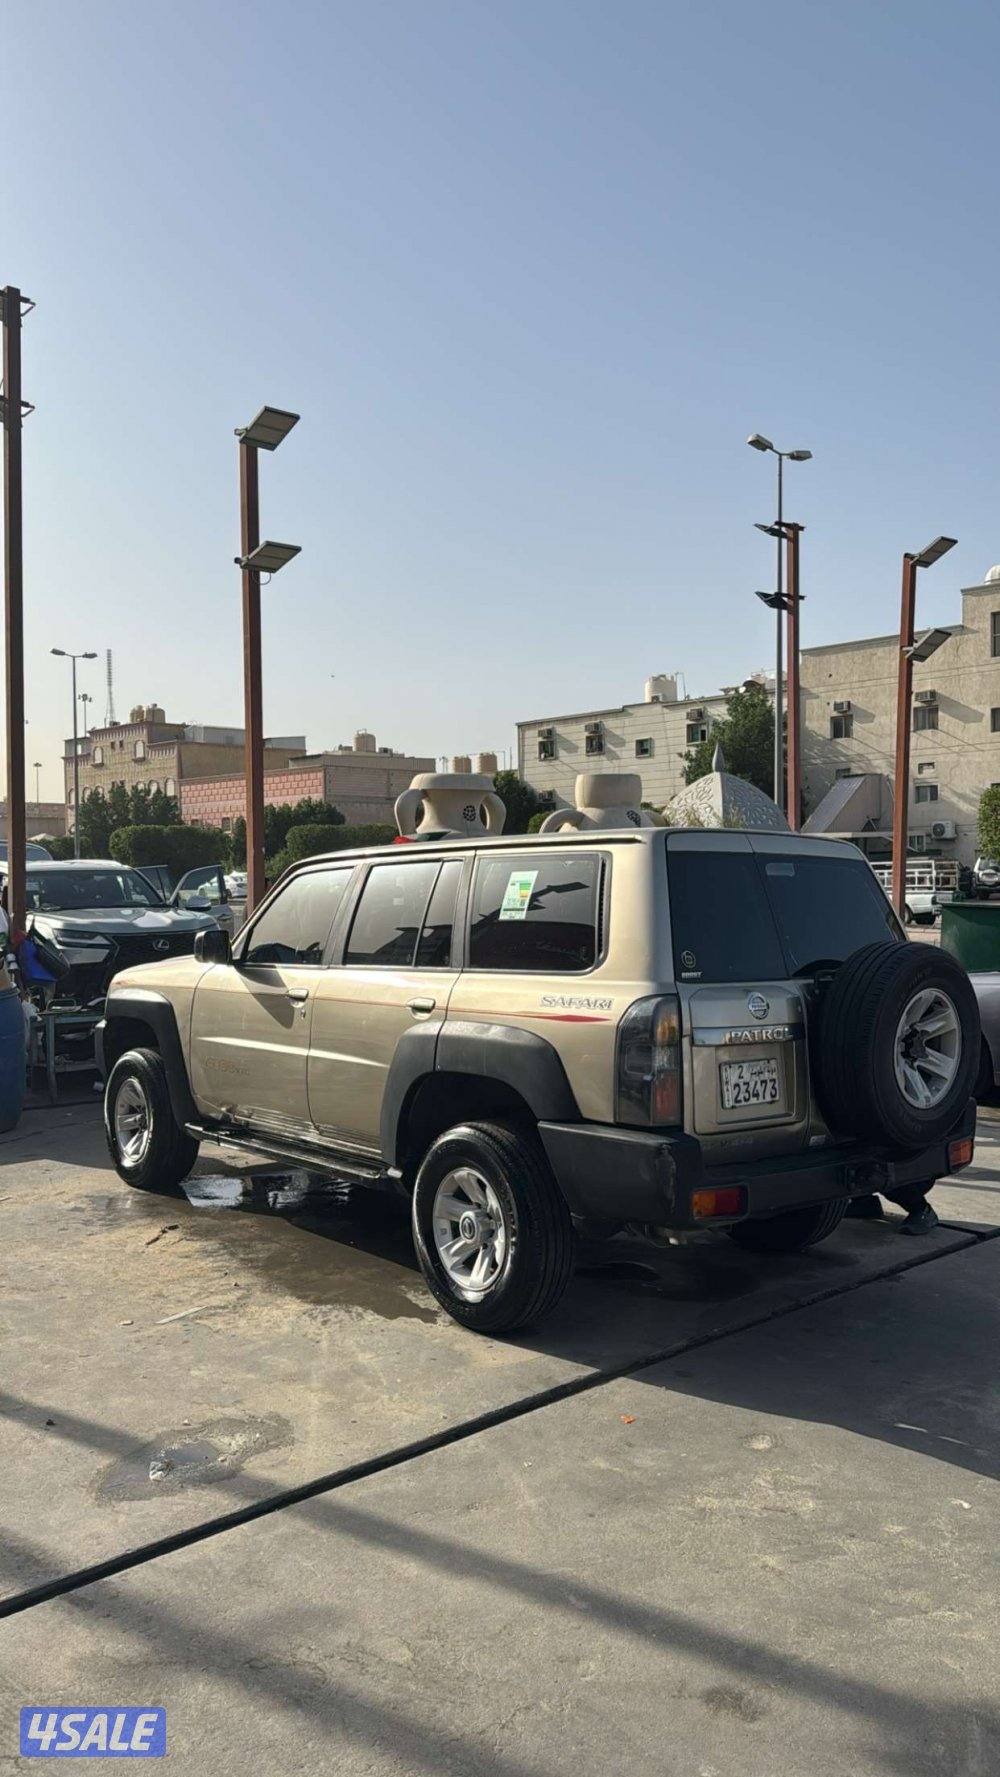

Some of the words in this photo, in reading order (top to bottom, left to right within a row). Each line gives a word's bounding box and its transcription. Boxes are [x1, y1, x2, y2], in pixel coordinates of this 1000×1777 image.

[540, 995, 614, 1010] SAFARI
[738, 1064, 744, 1079] 2
[733, 1078, 777, 1104] 23473
